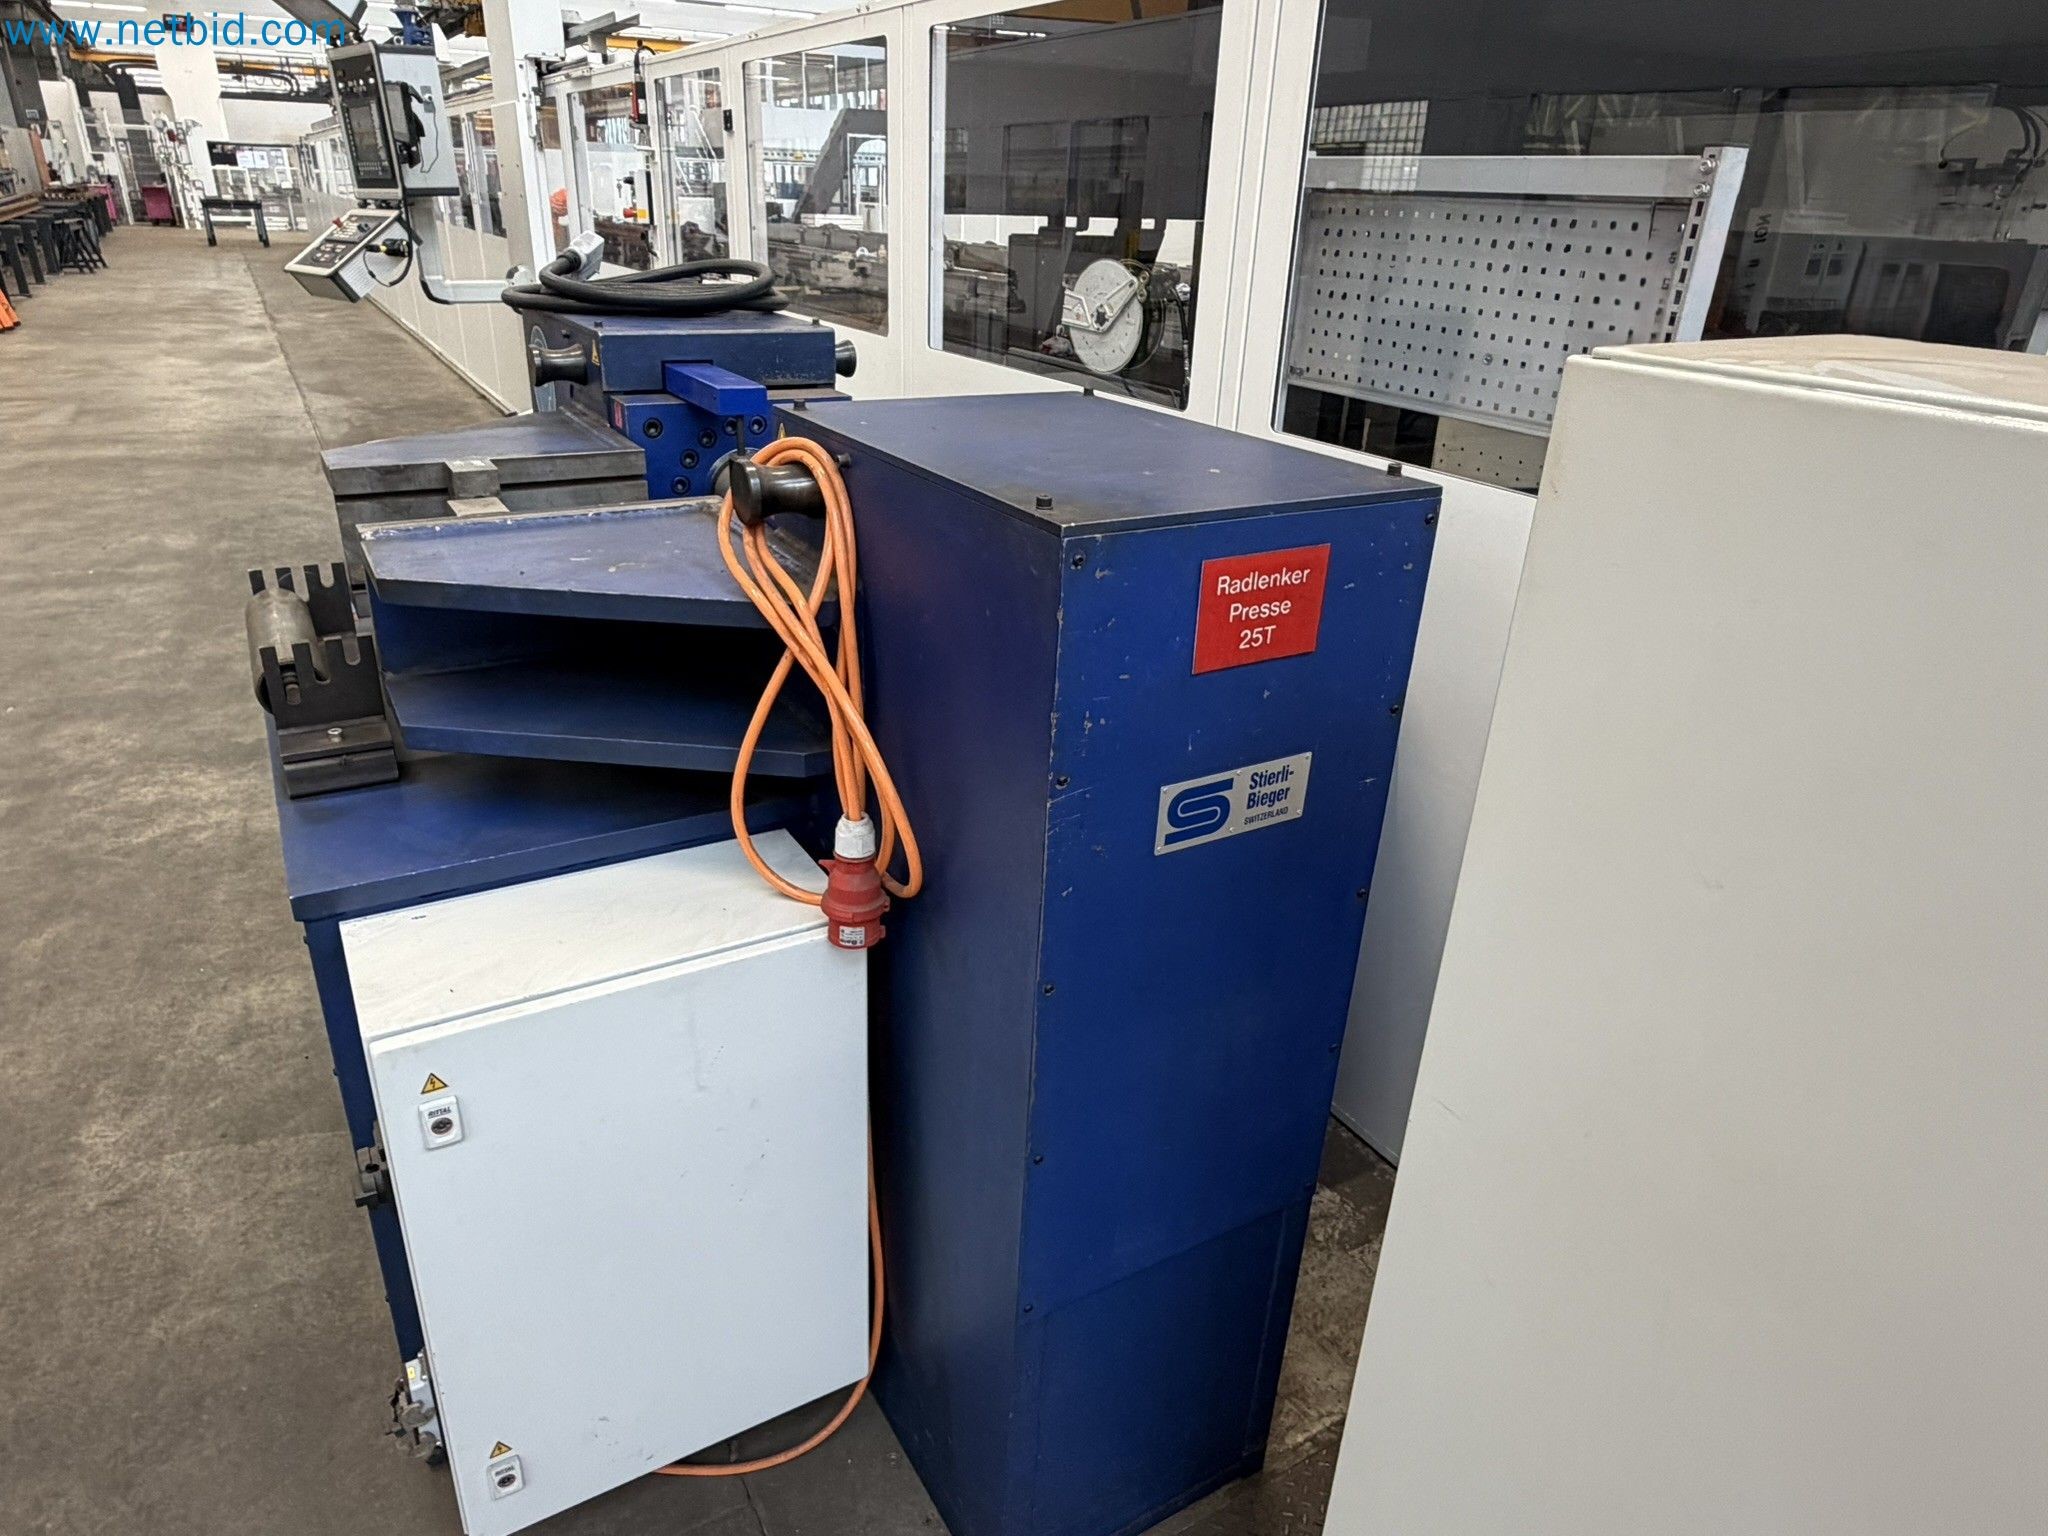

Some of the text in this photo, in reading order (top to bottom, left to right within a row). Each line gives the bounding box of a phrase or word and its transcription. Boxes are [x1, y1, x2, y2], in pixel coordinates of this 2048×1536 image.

[1216, 567, 1311, 596] Radlenker
[1229, 599, 1292, 623] Presse
[1238, 625, 1277, 650] 25T
[1249, 764, 1295, 791] Stierli-
[1246, 786, 1291, 810] Bieger
[1243, 806, 1289, 826] SWITZERLAND
